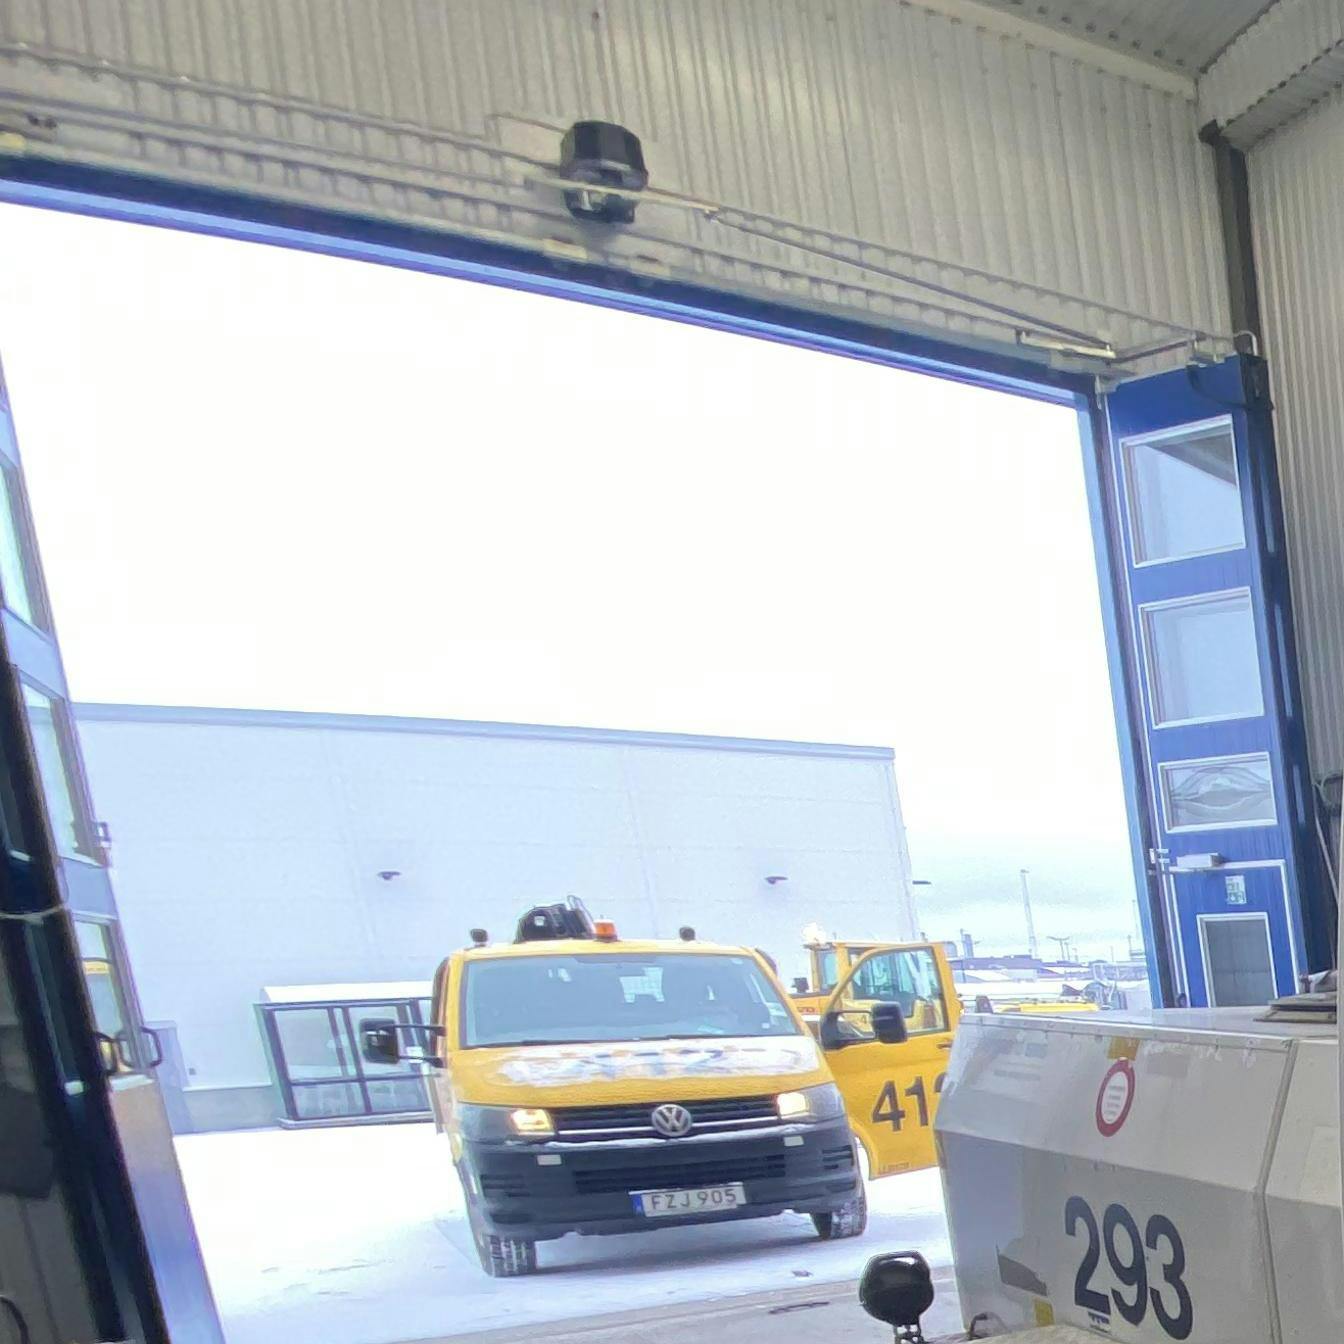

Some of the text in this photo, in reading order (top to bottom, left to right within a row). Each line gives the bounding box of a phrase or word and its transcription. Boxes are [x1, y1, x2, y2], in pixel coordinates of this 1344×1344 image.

[651, 1188, 737, 1210] FZJ 905
[1065, 1195, 1193, 1340] 293
